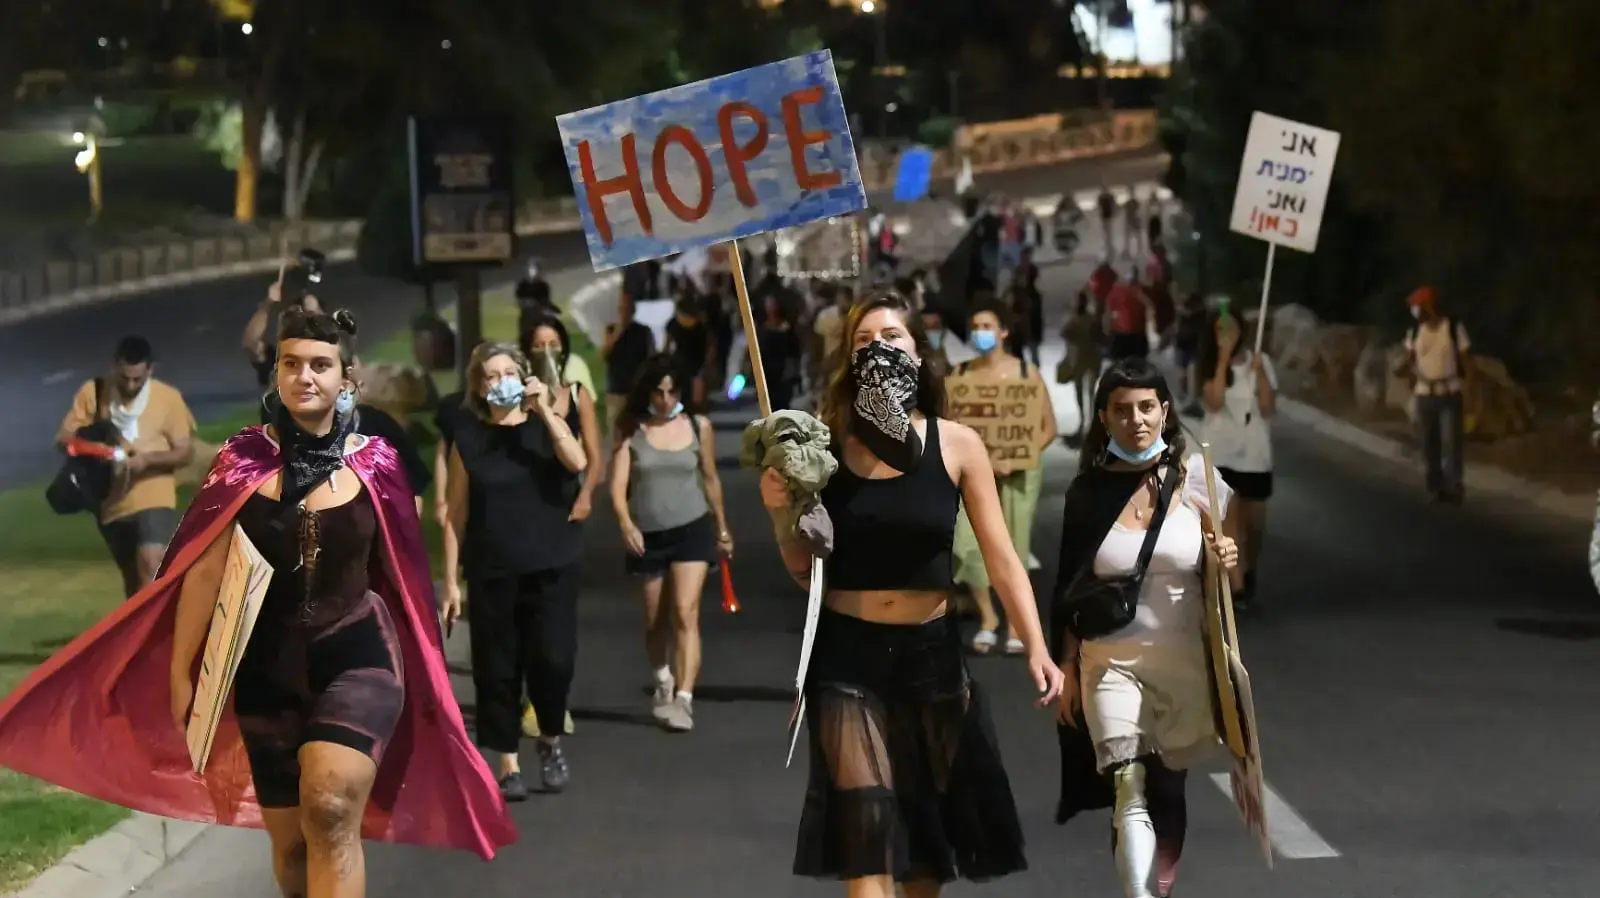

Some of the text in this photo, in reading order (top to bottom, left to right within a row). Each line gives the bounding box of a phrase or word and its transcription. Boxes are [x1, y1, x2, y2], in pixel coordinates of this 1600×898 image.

[1281, 129, 1317, 158] אני
[577, 85, 842, 249] HOPE
[1255, 159, 1314, 184] ימנית
[1267, 188, 1307, 214] ואני
[1248, 205, 1298, 238] כאן!
